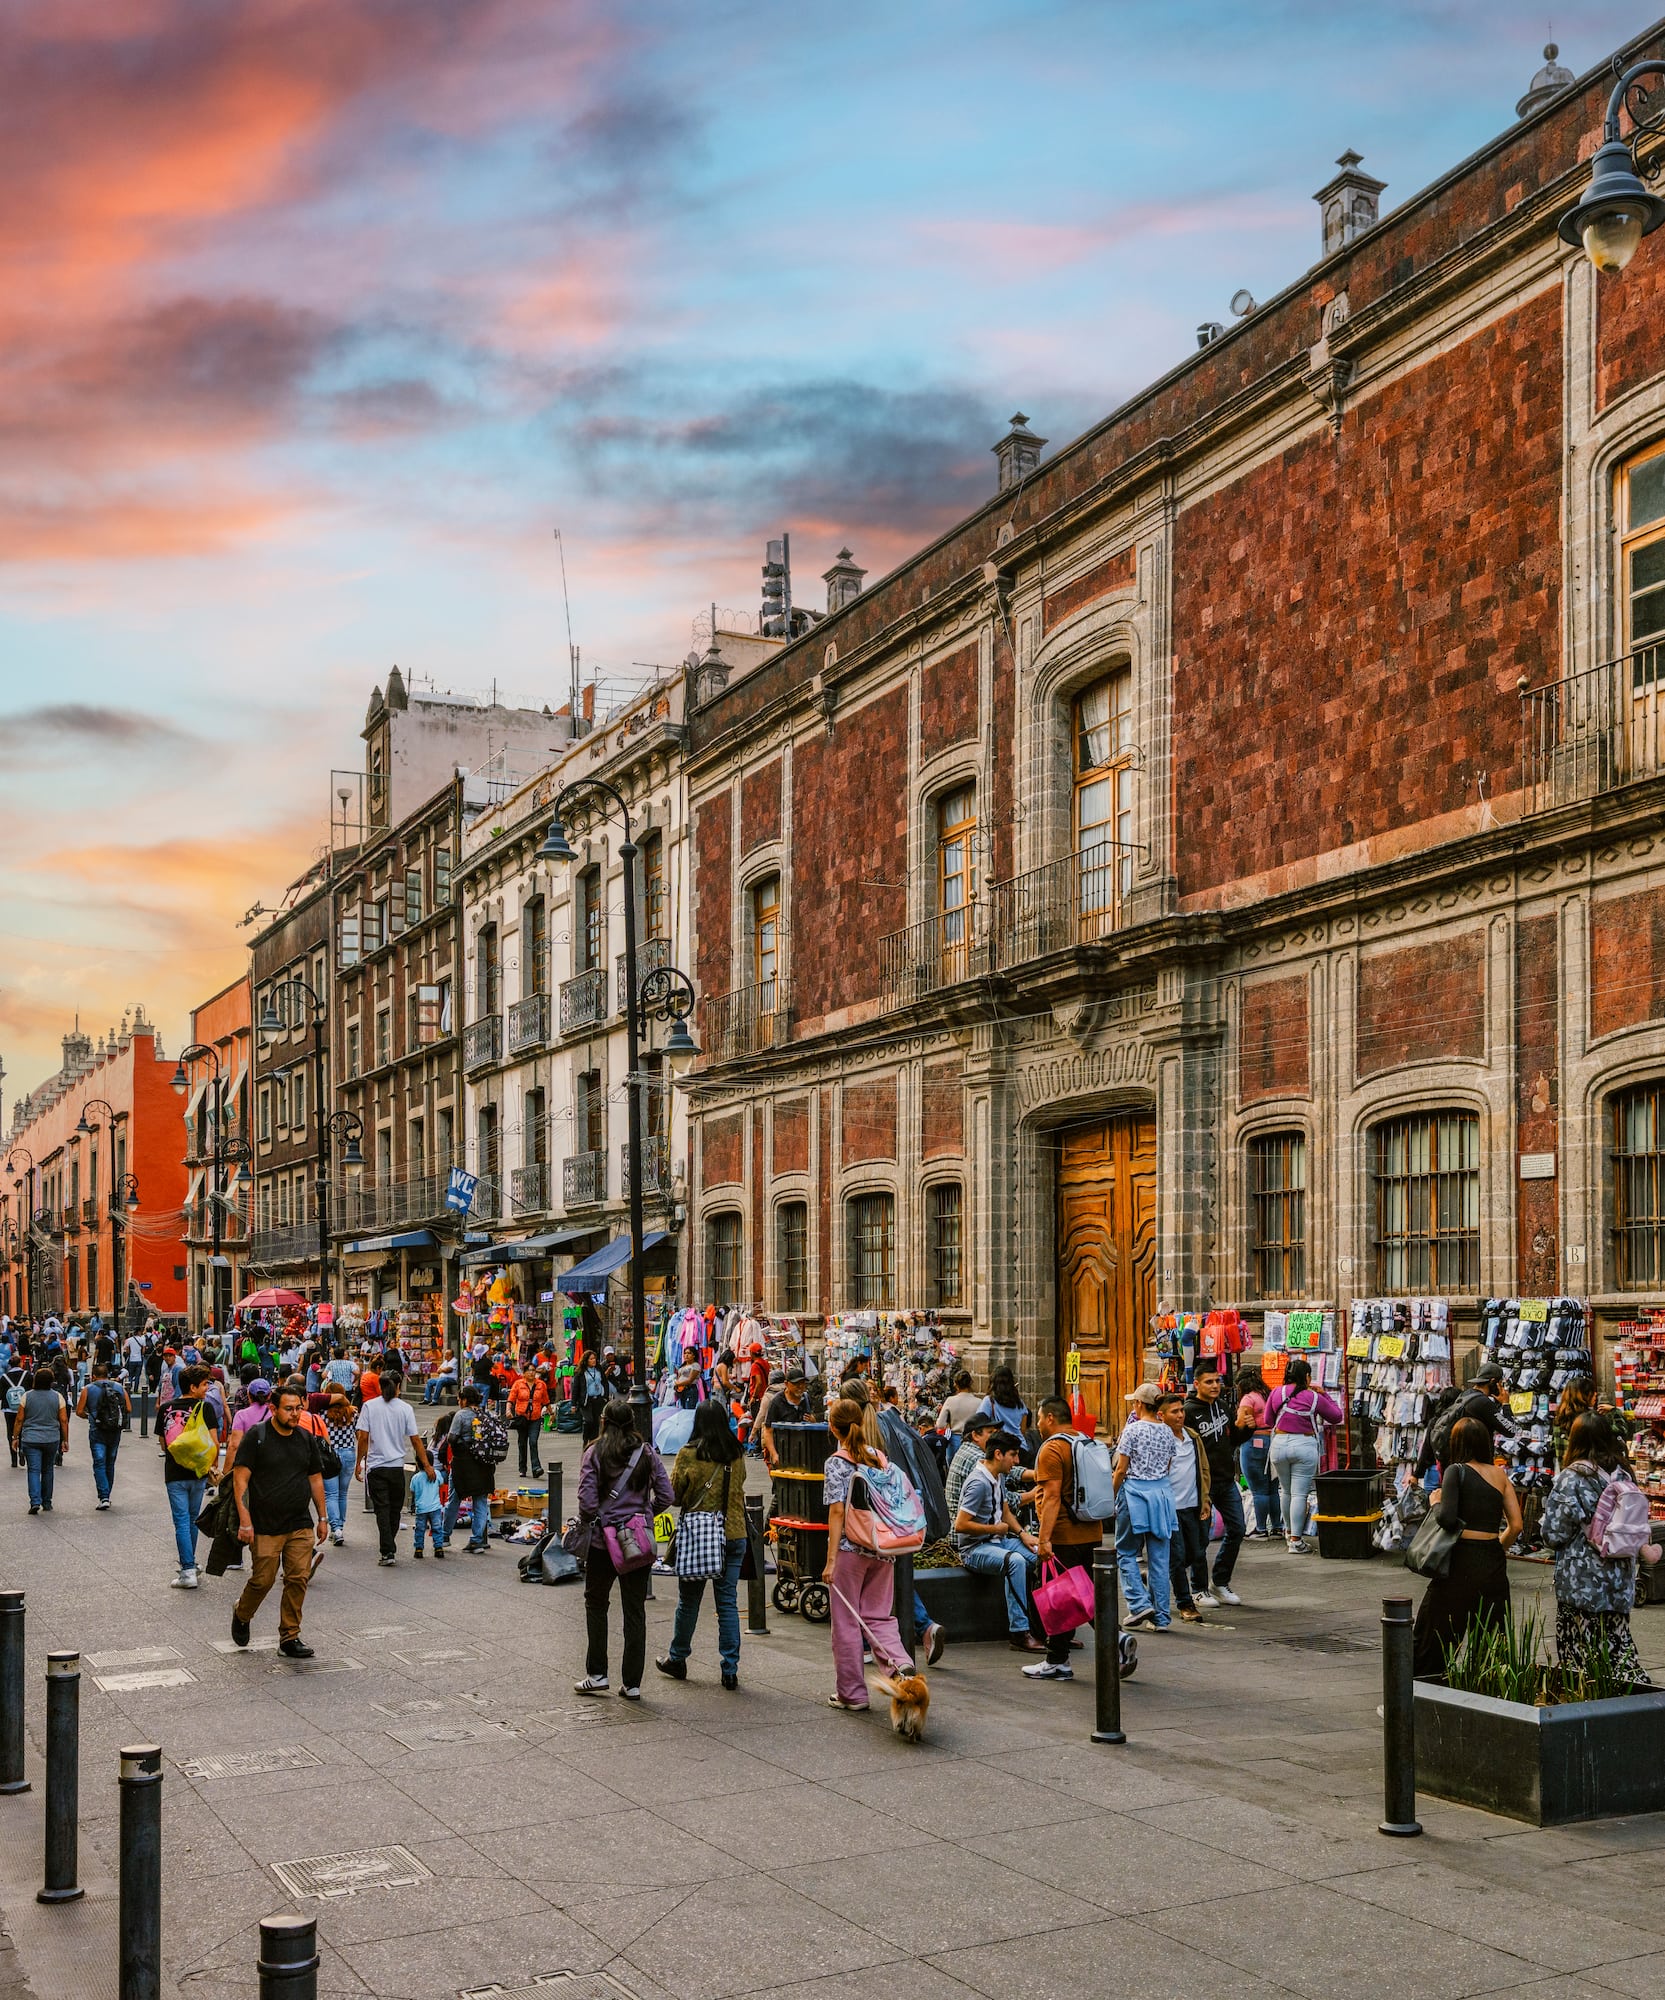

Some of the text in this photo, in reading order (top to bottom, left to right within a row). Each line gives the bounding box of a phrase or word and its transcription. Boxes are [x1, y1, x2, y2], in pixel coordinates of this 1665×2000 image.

[1571, 1247, 1580, 1263] B
[1340, 1259, 1348, 1273] C
[292, 1274, 317, 1287] MONEDA
[1288, 1322, 1319, 1333] LAVADORA
[1066, 1363, 1078, 1383] 10
[660, 1514, 673, 1538] 10
